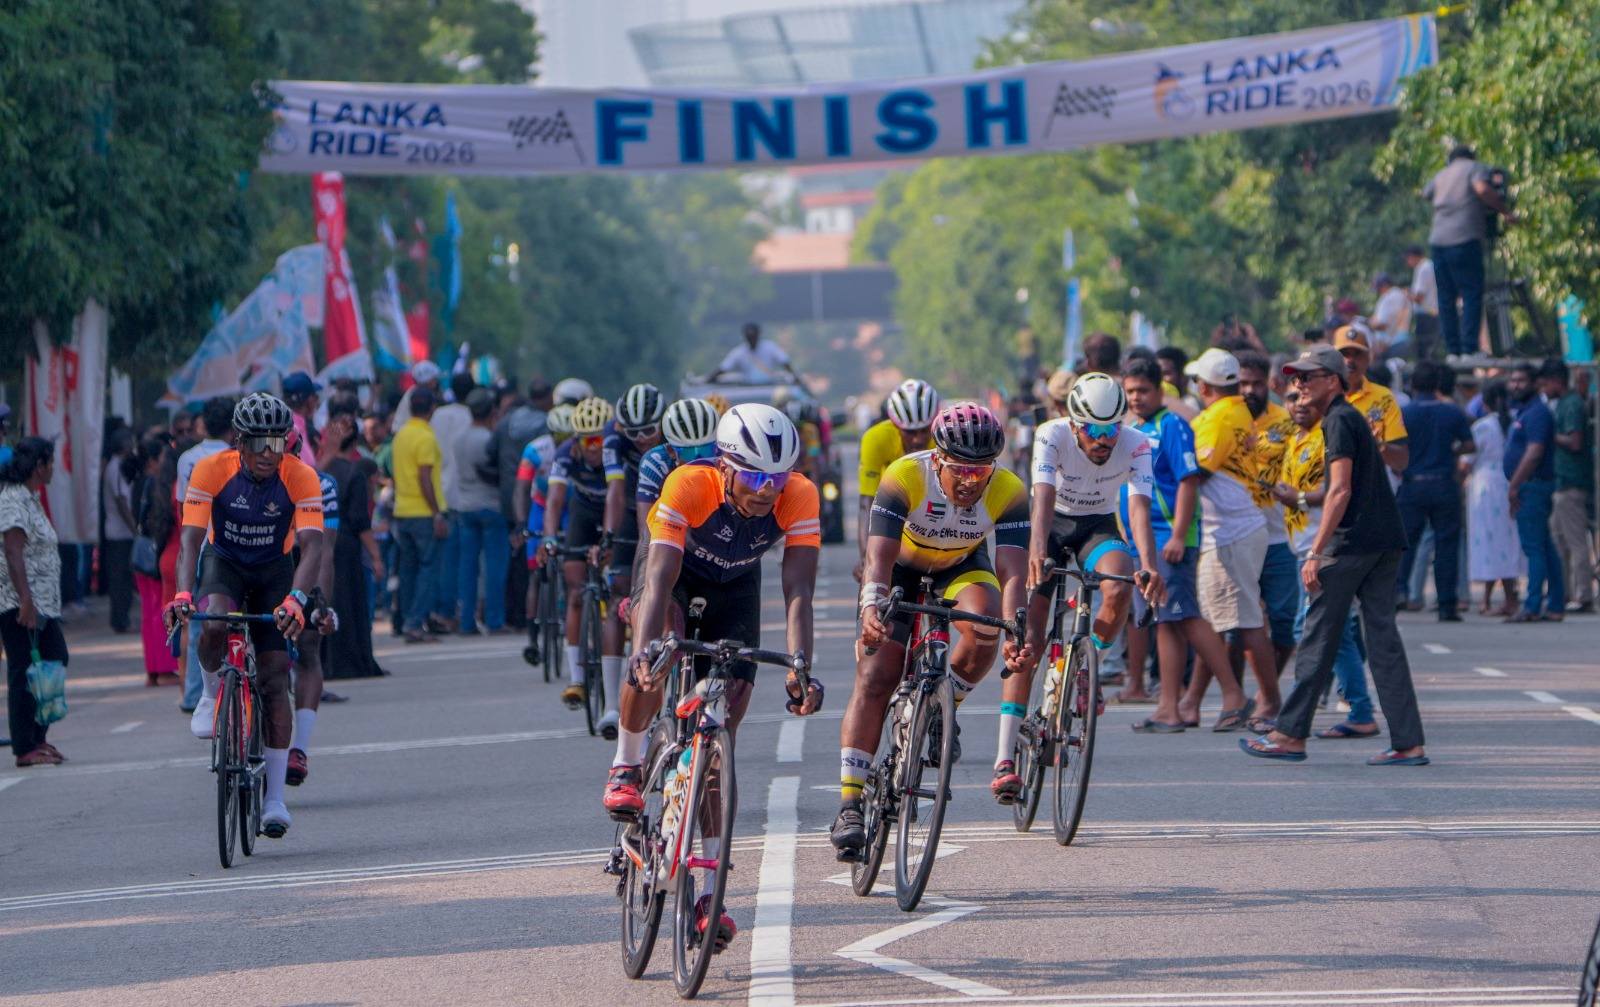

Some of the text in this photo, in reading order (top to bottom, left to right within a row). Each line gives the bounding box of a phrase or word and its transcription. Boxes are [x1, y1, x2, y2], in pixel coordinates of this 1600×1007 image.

[1203, 46, 1342, 86] LANKA
[308, 100, 448, 127] LANKA
[1206, 79, 1372, 116] RIDE 2026
[594, 78, 1029, 165] FINISH
[309, 130, 475, 165] RIDE 2026
[225, 520, 239, 532] SL
[909, 522, 928, 536] CIVIL
